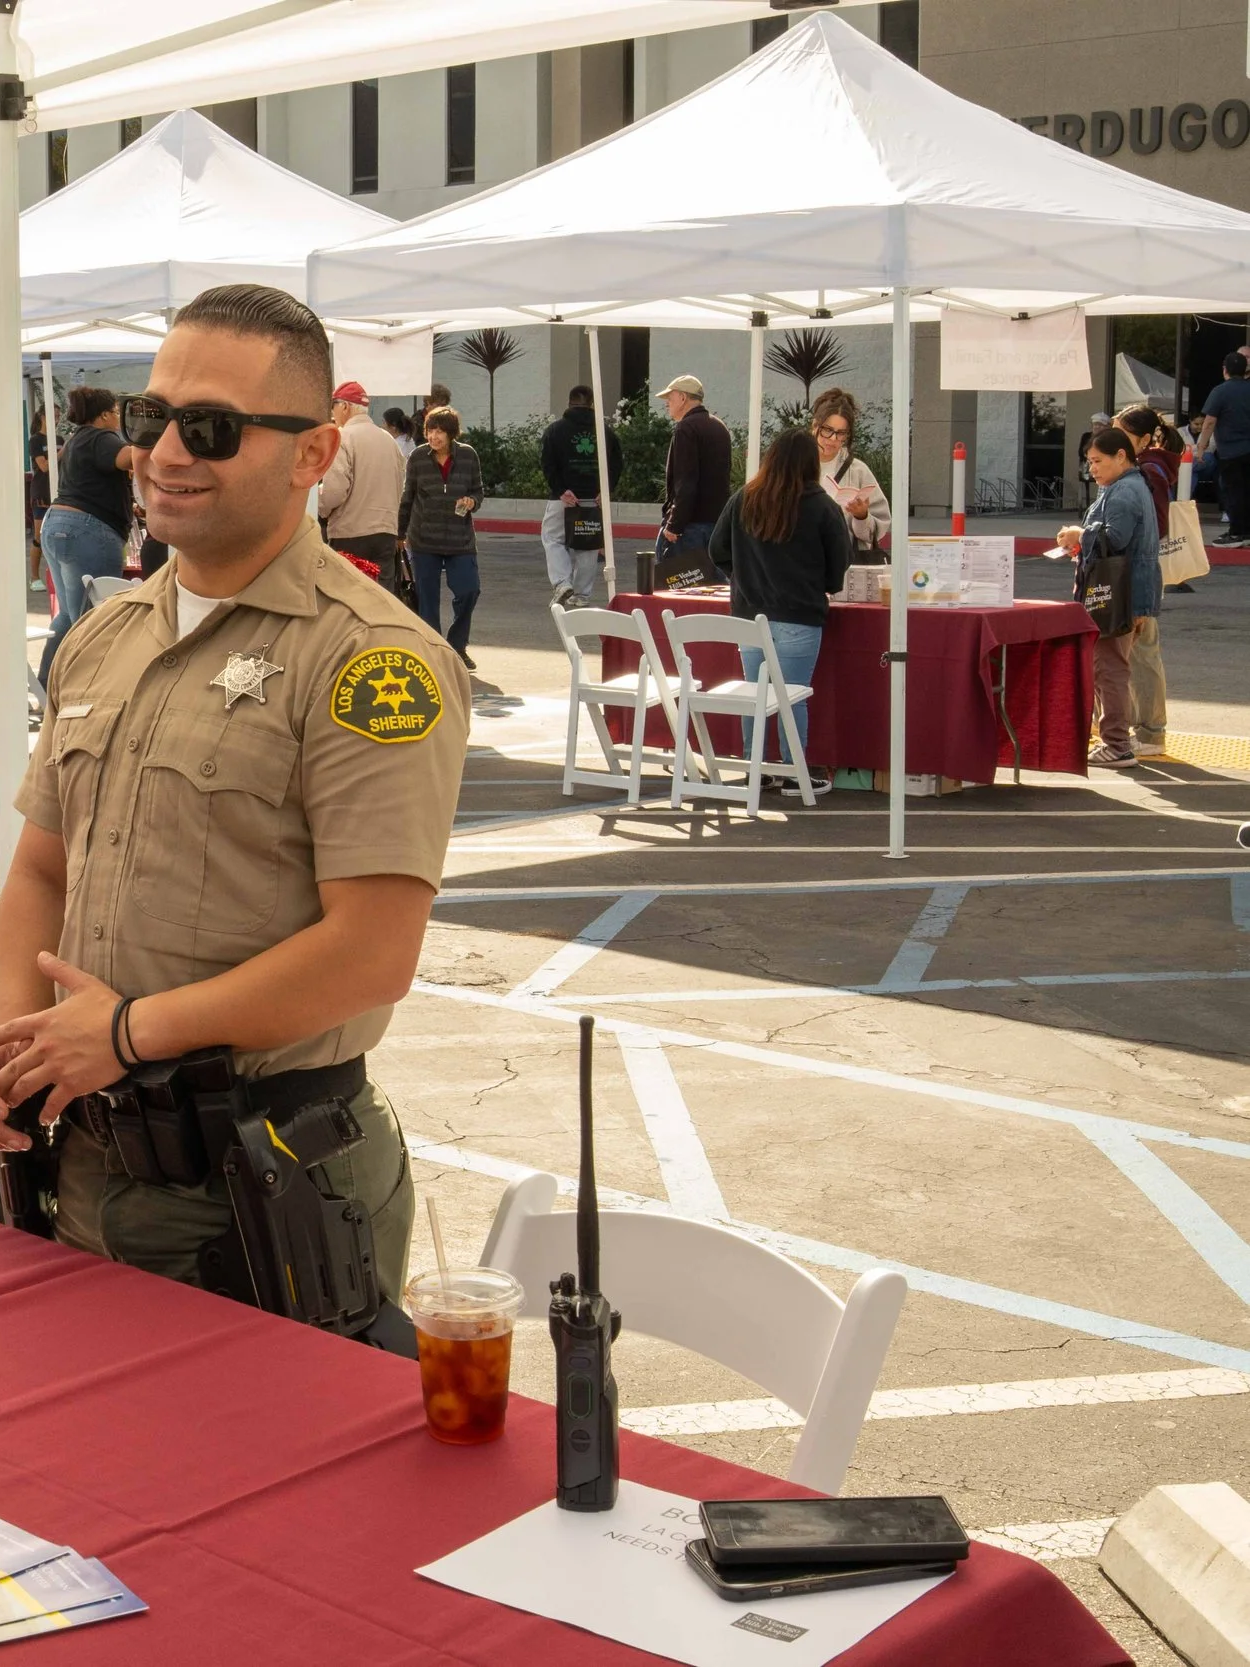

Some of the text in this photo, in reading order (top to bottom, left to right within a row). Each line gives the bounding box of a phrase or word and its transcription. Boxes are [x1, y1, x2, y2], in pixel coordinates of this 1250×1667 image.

[1010, 98, 1250, 158] RDUGO
[338, 653, 441, 714] LOS ANGELES COUNTY
[369, 714, 425, 732] SHERIFF
[640, 1524, 666, 1536] LA
[602, 1531, 672, 1556] NEEDS
